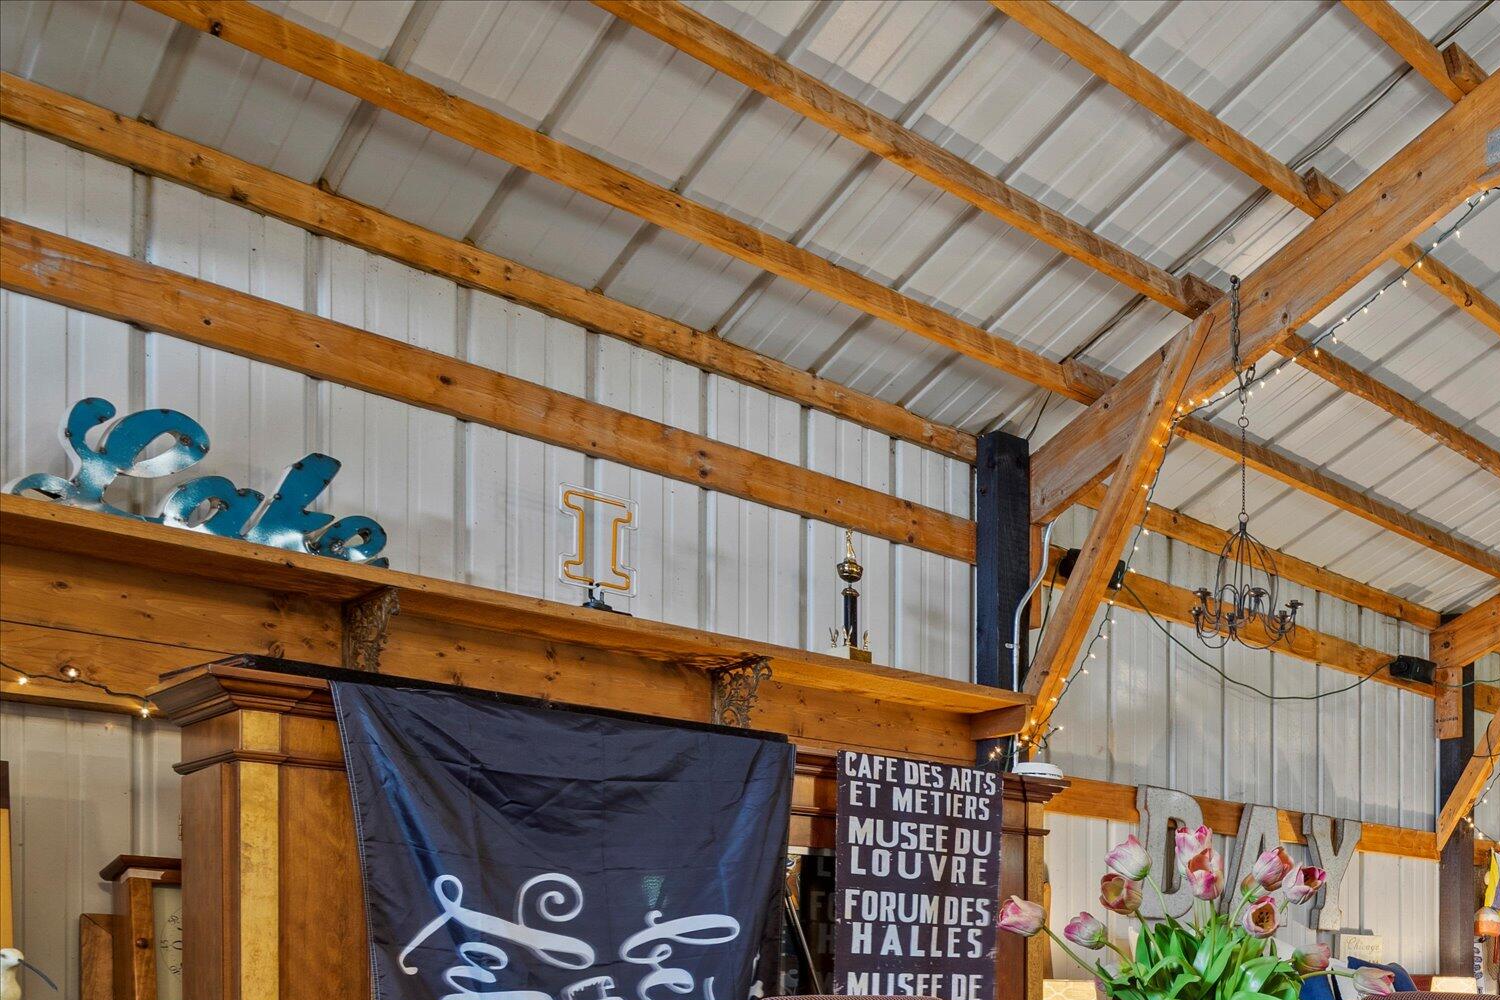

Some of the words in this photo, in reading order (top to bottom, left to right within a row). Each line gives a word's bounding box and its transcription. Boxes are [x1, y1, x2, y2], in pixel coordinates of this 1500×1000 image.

[3, 396, 390, 569] Lake
[844, 751, 897, 783] CAFE
[904, 760, 944, 790] DES
[949, 767, 996, 796] ARTS
[849, 781, 881, 809] ET
[892, 788, 990, 821] METIERS
[848, 816, 948, 853] MUSEE
[954, 827, 992, 856] DU
[850, 846, 987, 886] LOUVRE
[844, 888, 939, 926] FORUM
[944, 895, 990, 927] DES
[850, 921, 983, 959] HALLES
